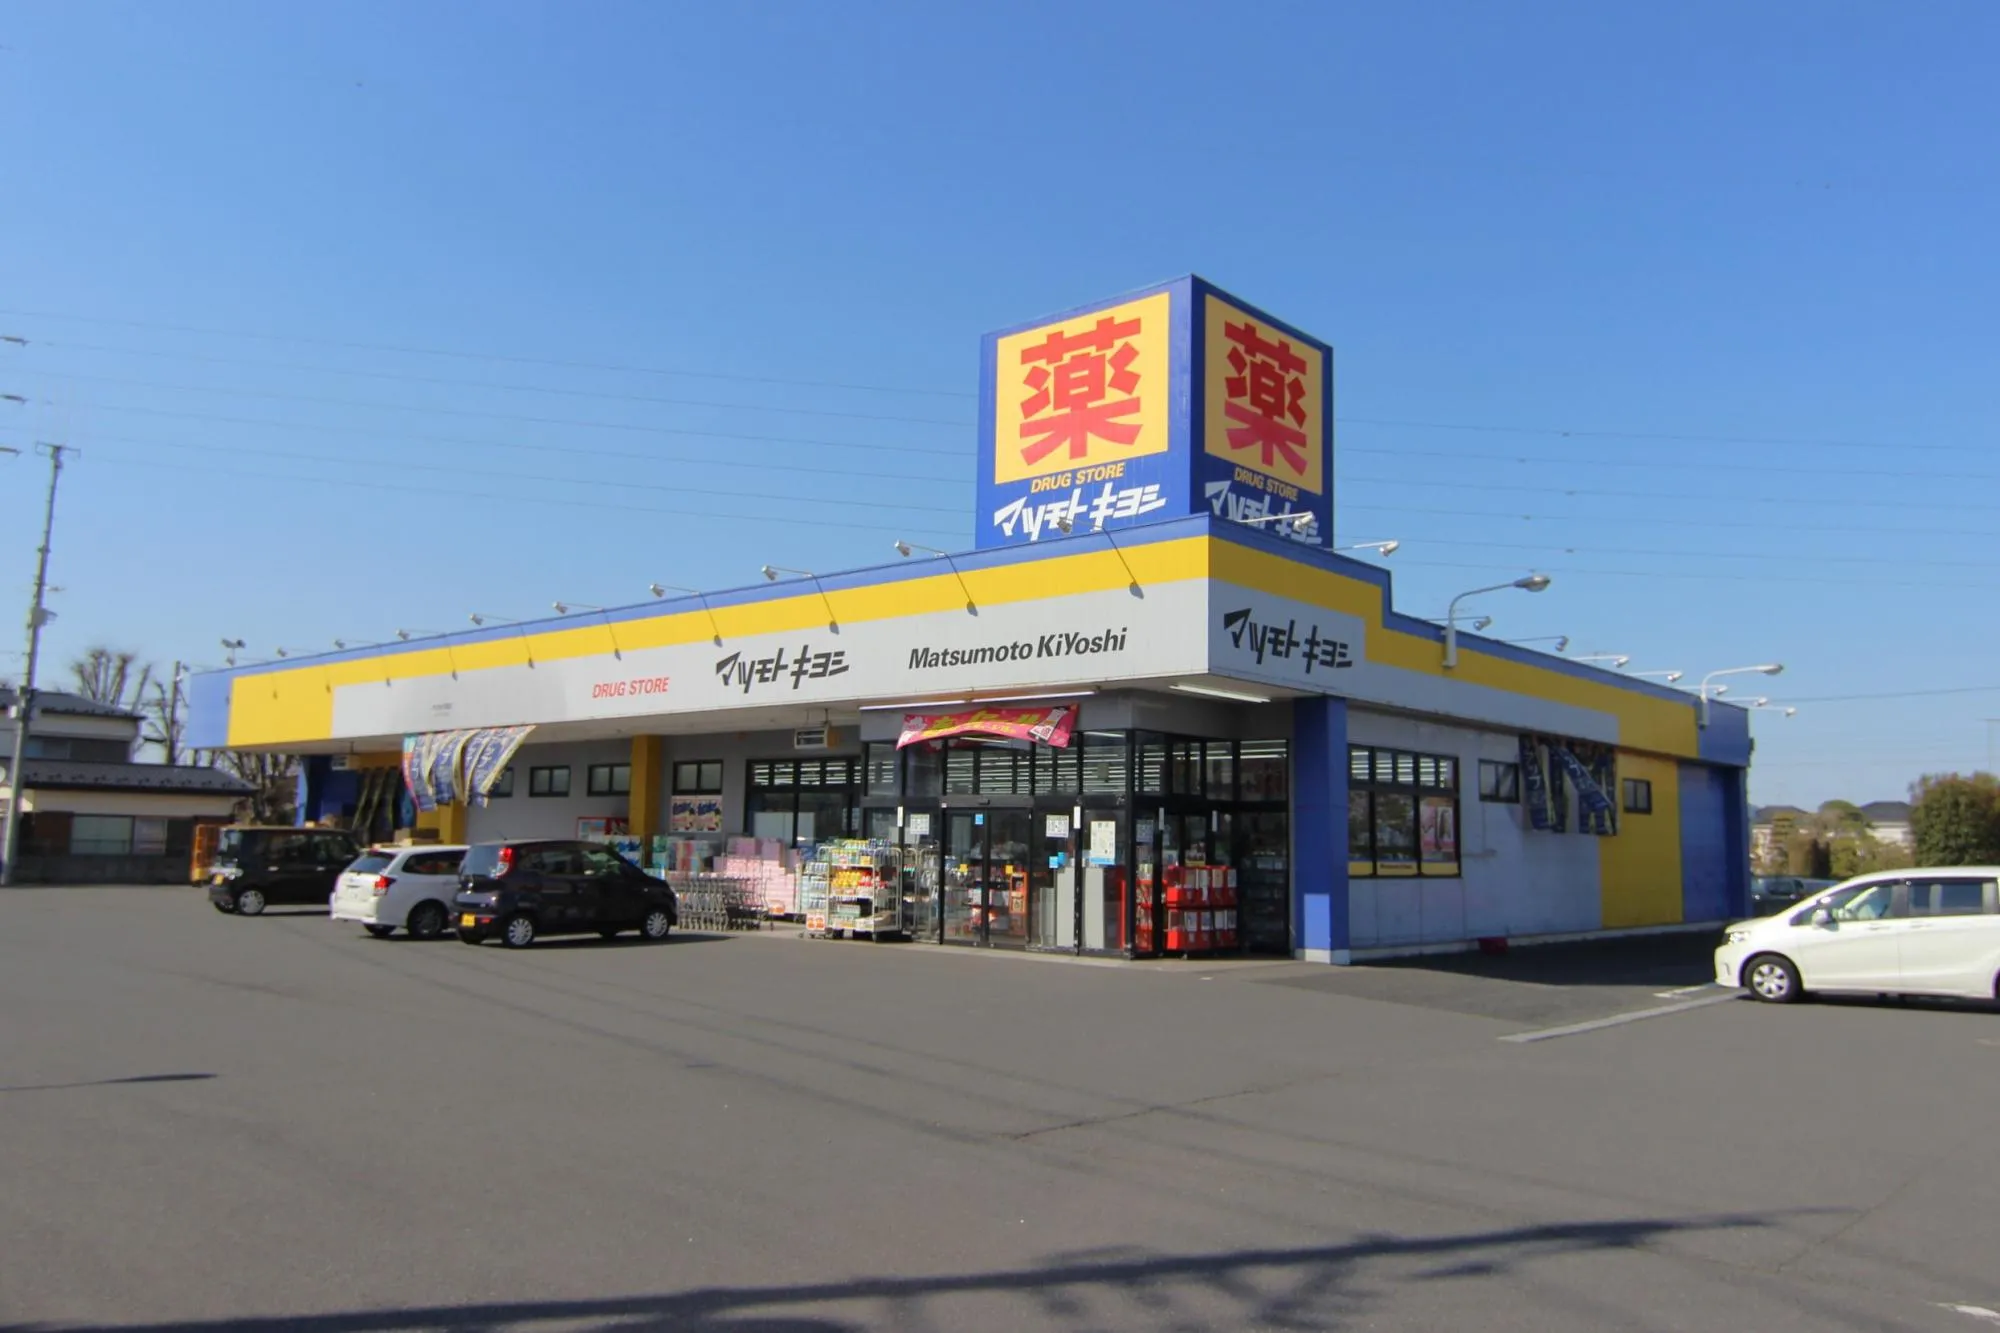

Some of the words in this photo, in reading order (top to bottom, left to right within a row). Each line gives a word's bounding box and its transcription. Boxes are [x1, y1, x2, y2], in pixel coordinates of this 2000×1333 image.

[1019, 316, 1143, 466] 薬
[1224, 320, 1308, 476] 薬
[1031, 473, 1072, 493] DRUG
[1075, 462, 1126, 485] STORE
[1234, 467, 1265, 490] DRUG
[1266, 478, 1299, 501] STORE
[909, 641, 1033, 669] Matsumoto
[1036, 627, 1128, 658] KiYoshi
[1224, 608, 1353, 674] マツモトキヨシ
[592, 681, 625, 698] DRUG
[628, 677, 670, 697] STORE
[716, 644, 849, 694] マツモトキヨシ
